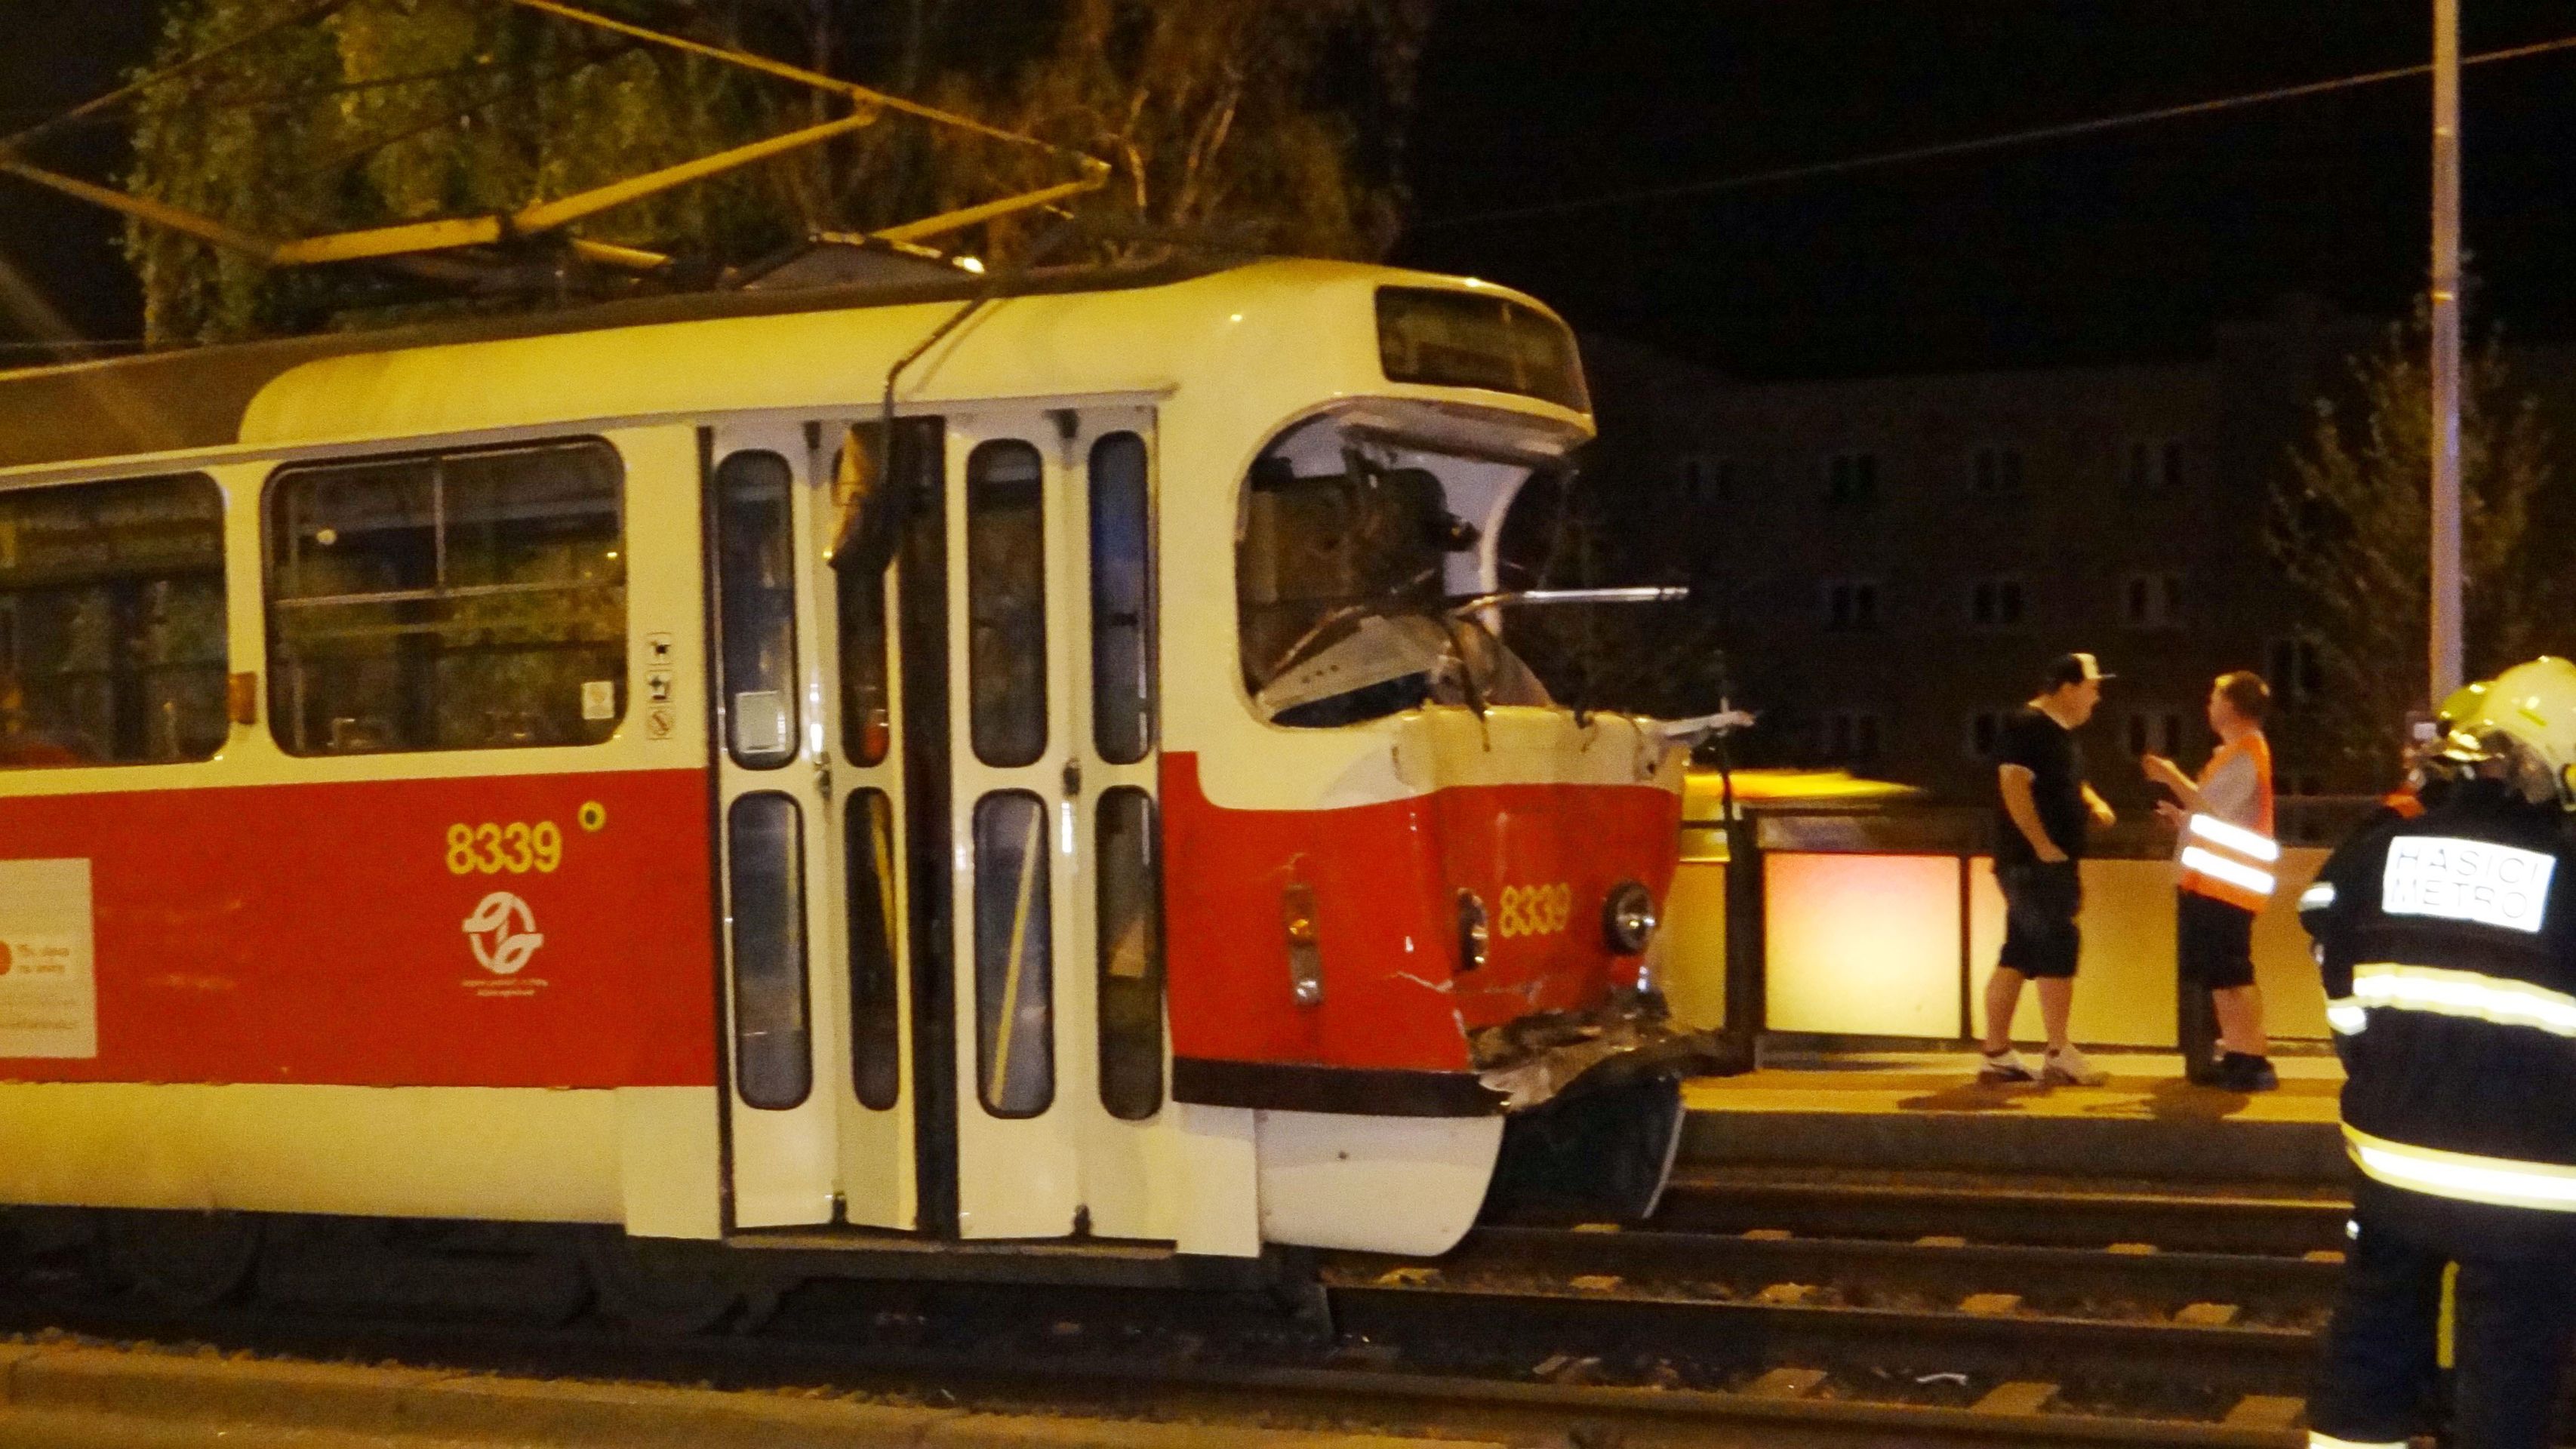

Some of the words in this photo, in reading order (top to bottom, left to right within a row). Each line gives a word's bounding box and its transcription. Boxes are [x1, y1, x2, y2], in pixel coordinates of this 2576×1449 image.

[446, 821, 562, 874] 8339
[1500, 883, 1571, 937] 8339
[2391, 878, 2527, 918] METRO
